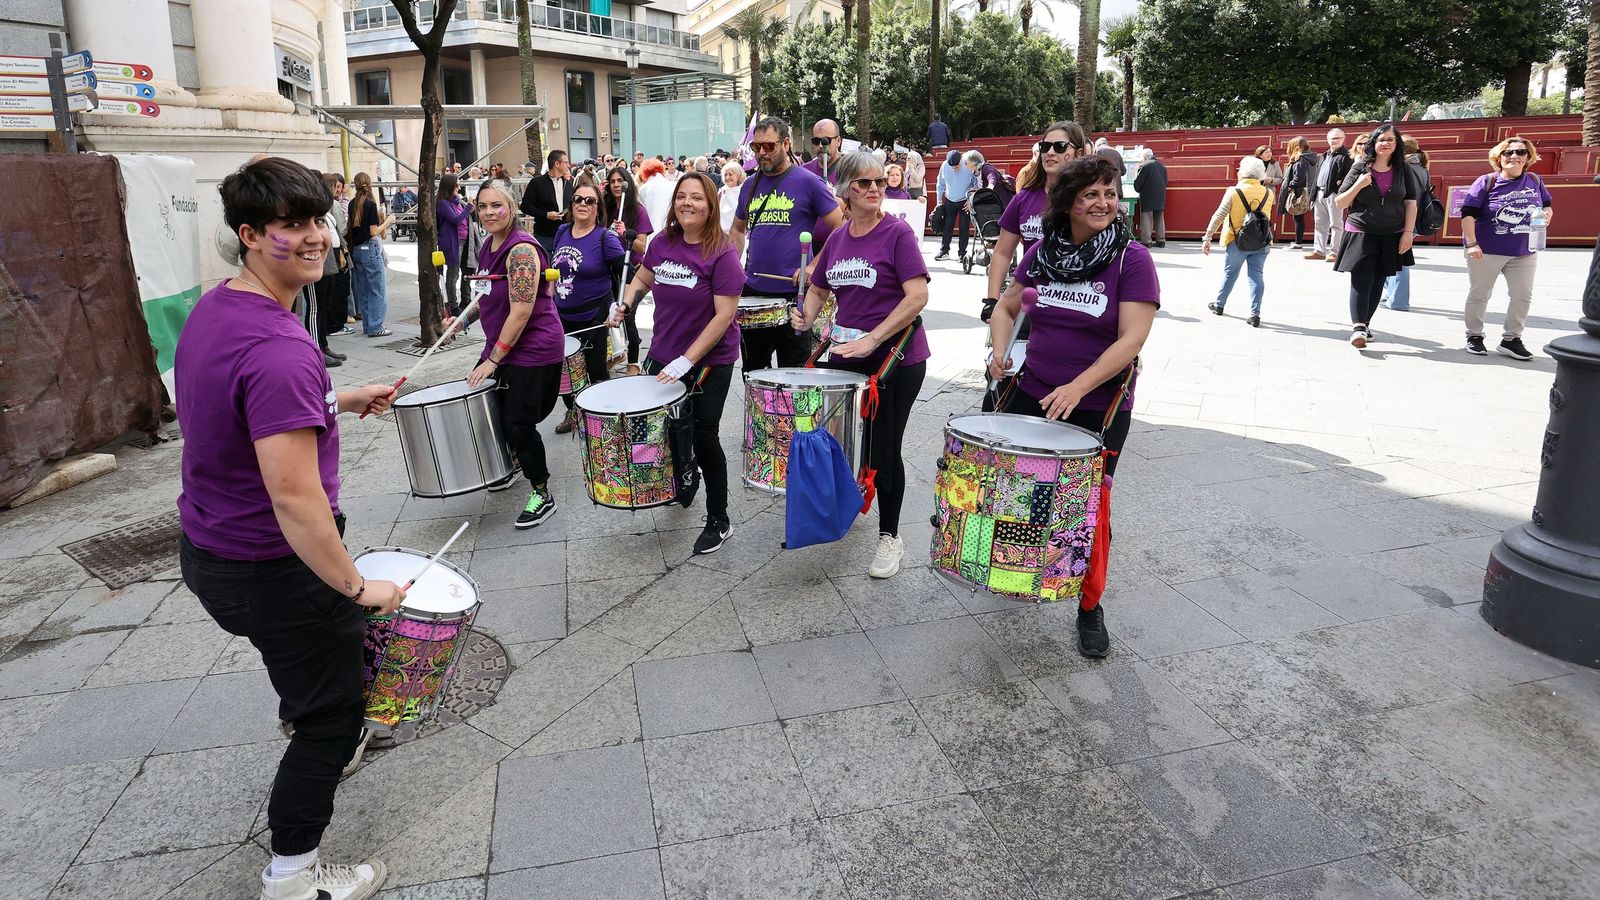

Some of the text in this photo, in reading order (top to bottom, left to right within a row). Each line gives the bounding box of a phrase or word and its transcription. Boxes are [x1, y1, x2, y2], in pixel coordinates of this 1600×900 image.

[172, 194, 198, 213] Fundación
[827, 269, 871, 281] SAMBASUR
[1040, 287, 1100, 306] SAMBASUR
